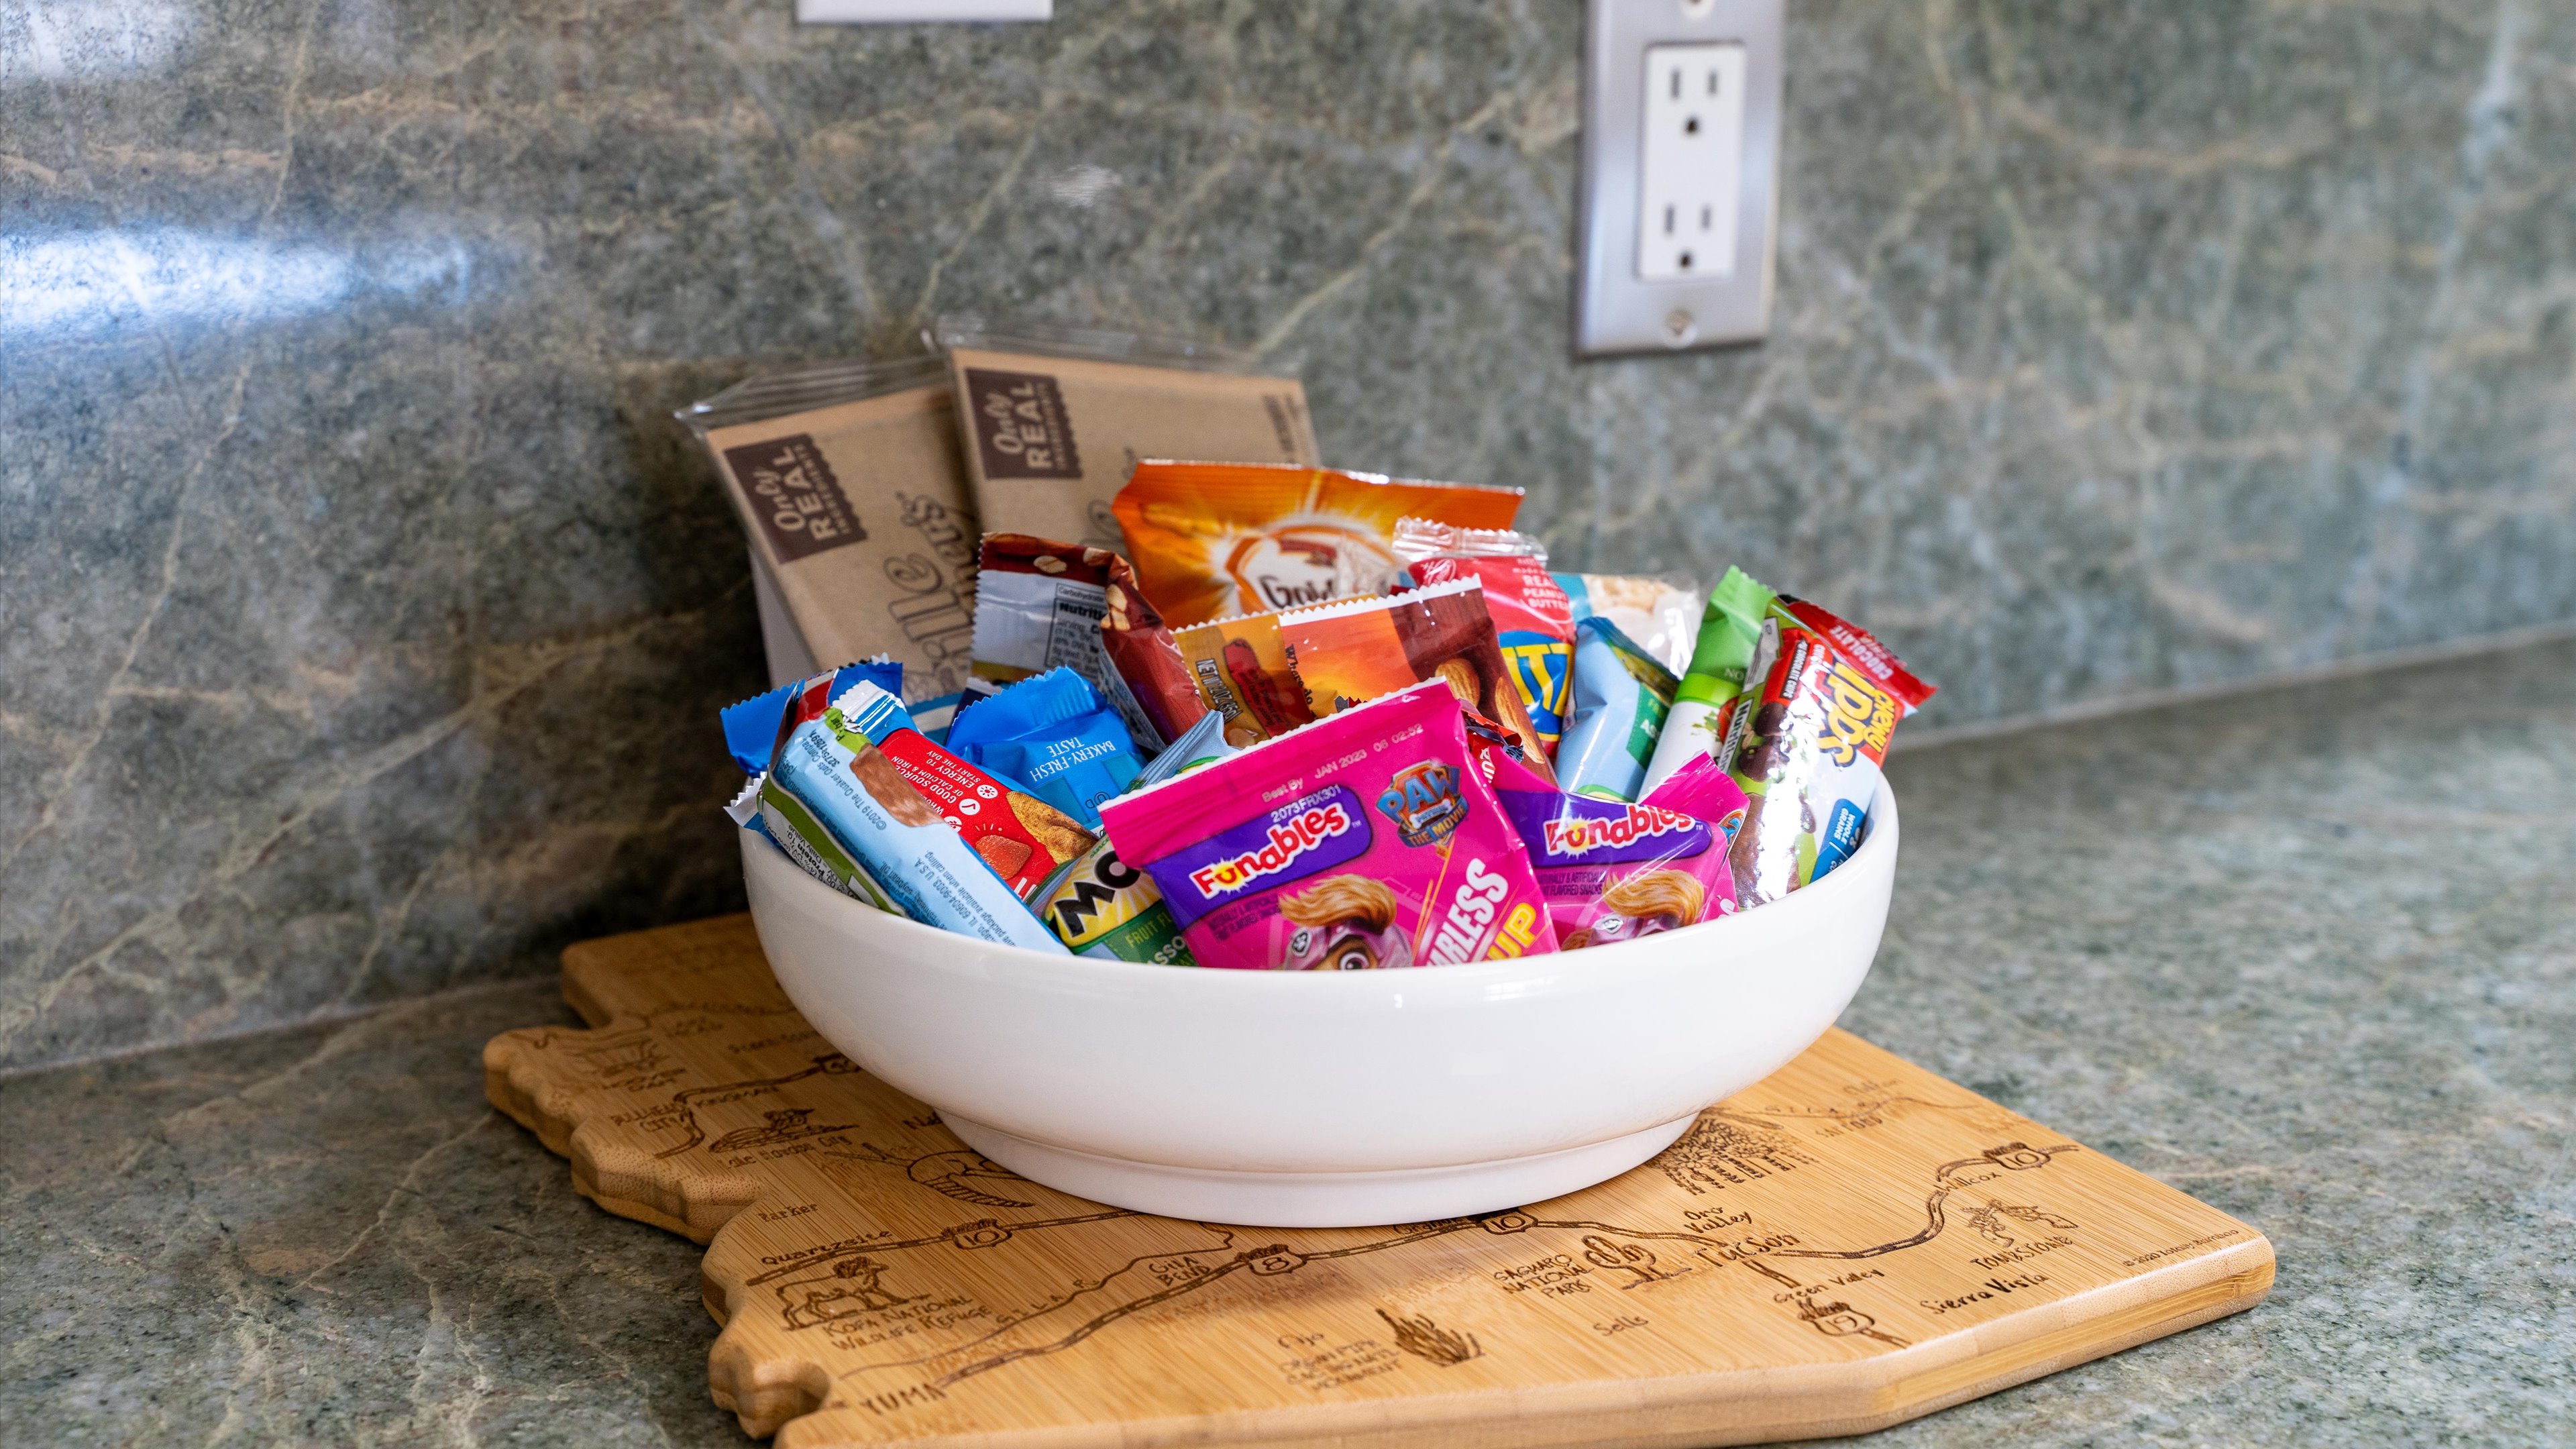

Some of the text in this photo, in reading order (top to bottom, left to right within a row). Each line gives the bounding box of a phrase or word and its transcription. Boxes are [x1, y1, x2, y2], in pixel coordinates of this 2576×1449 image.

[985, 393, 1024, 454] Only
[1011, 382, 1054, 469] REAL
[755, 467, 806, 532] Only
[773, 445, 838, 541] REAL
[1523, 576, 1557, 588] REA
[1059, 602, 1107, 621] Nutriti
[1828, 623, 1894, 682] CHOCOLATE
[1195, 659, 1219, 676] NET
[1500, 643, 1573, 716] ITZ
[800, 737, 822, 763] Compa
[1029, 740, 1115, 781] BAKERY-FRESH
[1046, 737, 1084, 757] TASTE
[816, 759, 833, 776] Oats
[890, 755, 912, 769] IRON
[926, 750, 980, 782] START THE DAY
[926, 757, 975, 788] ENERGY TO
[1262, 785, 1288, 802] Best
[1288, 777, 1303, 791] By
[1314, 761, 1338, 780] JAN
[1338, 749, 1367, 769] 2023
[828, 771, 854, 796] Quaker
[917, 769, 953, 790] CALCIUM
[928, 783, 957, 803] GOOD
[952, 788, 963, 796] OF
[1375, 762, 1464, 824] PAW
[849, 793, 865, 808] The
[784, 829, 796, 843] 1g,
[1407, 831, 1432, 845] THE
[1431, 804, 1465, 836] MOVIE
[1544, 805, 1694, 853] Funables
[1833, 807, 1849, 840] GRAINS
[1840, 814, 1856, 845] WHOLE
[796, 843, 825, 875] Protein
[923, 849, 946, 873] calling.
[1191, 804, 1348, 896] Funables
[912, 856, 936, 881] U.S.A.
[941, 870, 960, 889] when
[956, 885, 983, 914] available
[1426, 858, 1509, 967] ARLESS
[1124, 920, 1159, 949] FRUIT
[1487, 902, 1536, 961] UP
[1933, 1173, 2002, 1197] Willcox
[758, 1203, 818, 1223] Parker
[1491, 1215, 1526, 1232] 10
[1684, 1207, 1724, 1222] Oro
[1684, 1211, 1754, 1234] Valley
[761, 1229, 894, 1266] Quartzsite
[966, 1230, 999, 1247] 10
[1155, 1265, 1210, 1287] BEND
[1262, 1255, 1292, 1272] 8
[1493, 1253, 1574, 1282] SAGUARO
[1504, 1265, 1594, 1295] NATIONAL
[1542, 1279, 1593, 1299] PARK
[1773, 1267, 1886, 1304] Green Valley
[1919, 1272, 2050, 1316] Sierra Vista
[825, 1295, 973, 1338] KOFA NATIONAL
[831, 1304, 993, 1350] WILDLIFE REFUGE
[1593, 1315, 1649, 1336] Sells
[861, 1381, 947, 1416] YUMA
